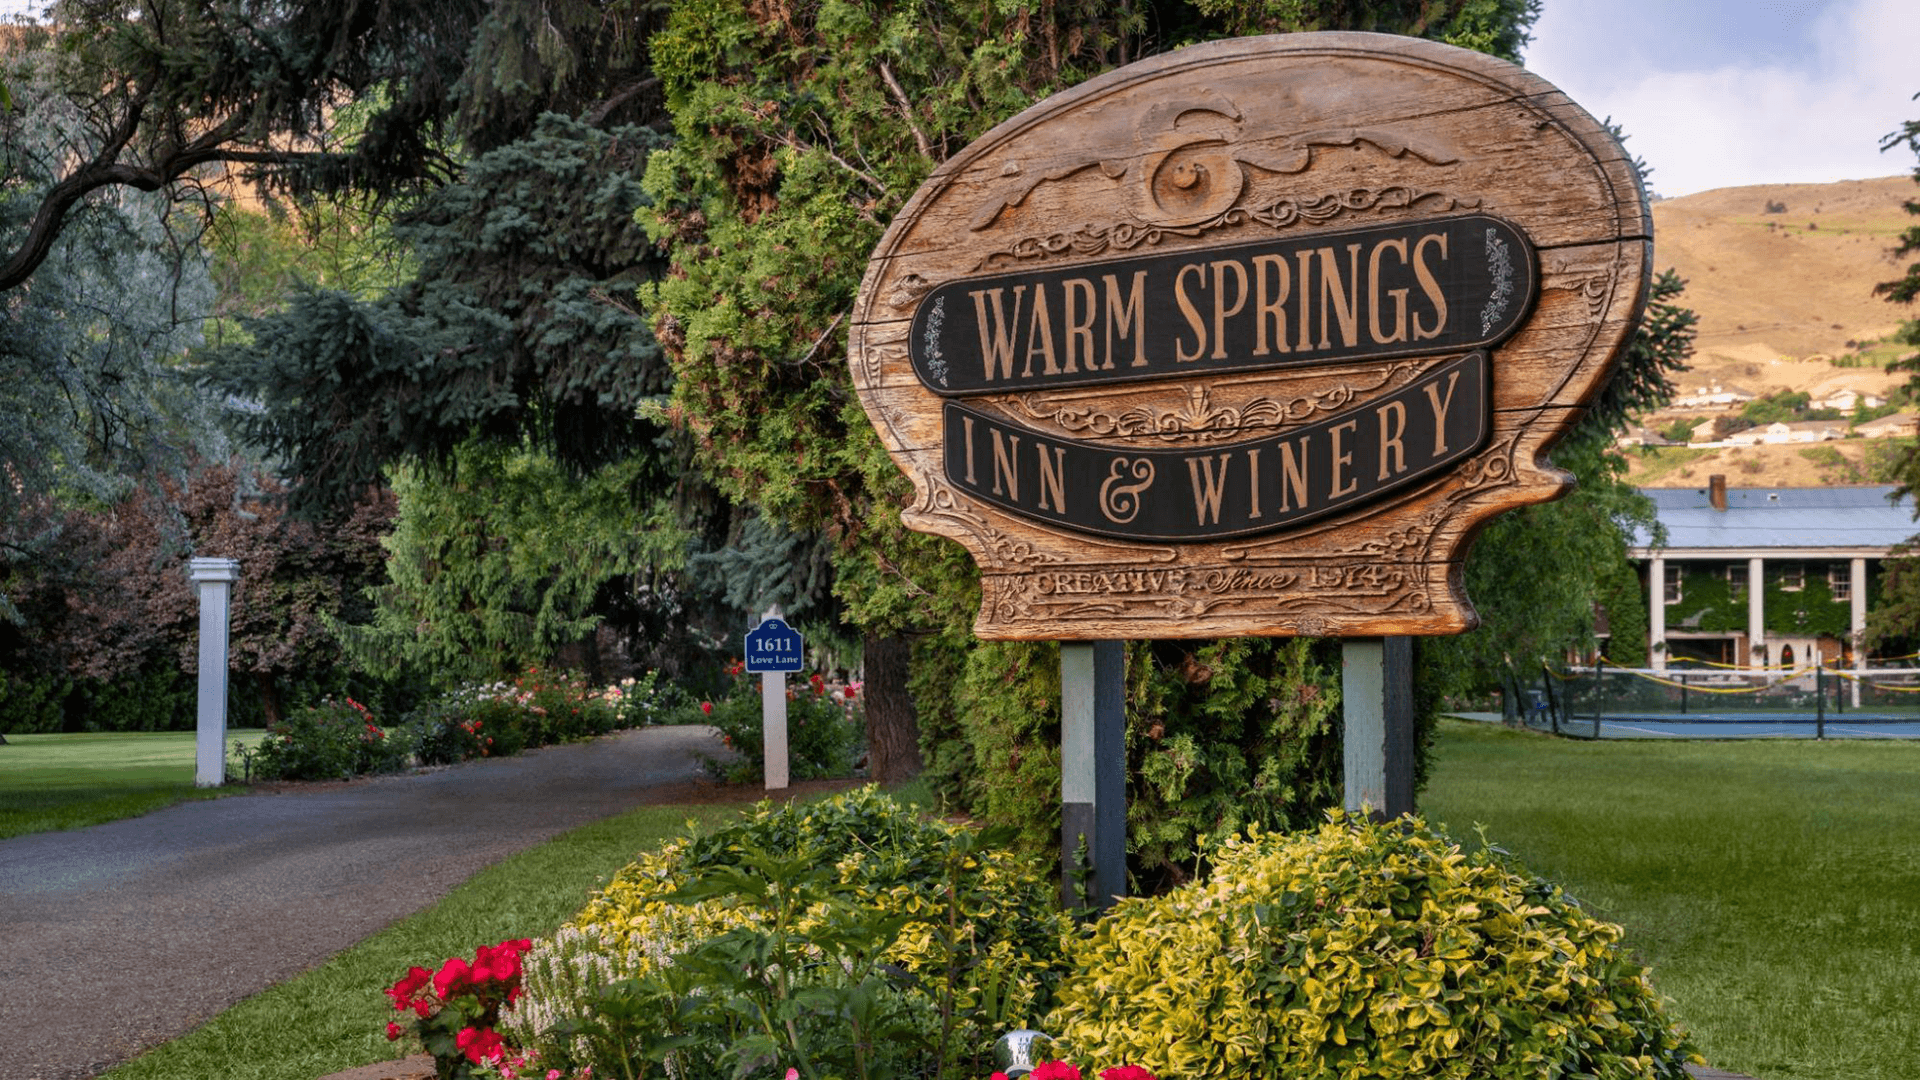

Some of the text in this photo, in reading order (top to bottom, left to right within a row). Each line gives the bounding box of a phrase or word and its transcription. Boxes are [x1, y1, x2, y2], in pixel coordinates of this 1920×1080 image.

[969, 233, 1449, 381] WARM SPRINGS
[962, 370, 1459, 526] INN & WINERY
[1205, 568, 1297, 594] Since
[756, 637, 792, 652] 1611
[750, 655, 798, 664] Love Lane
